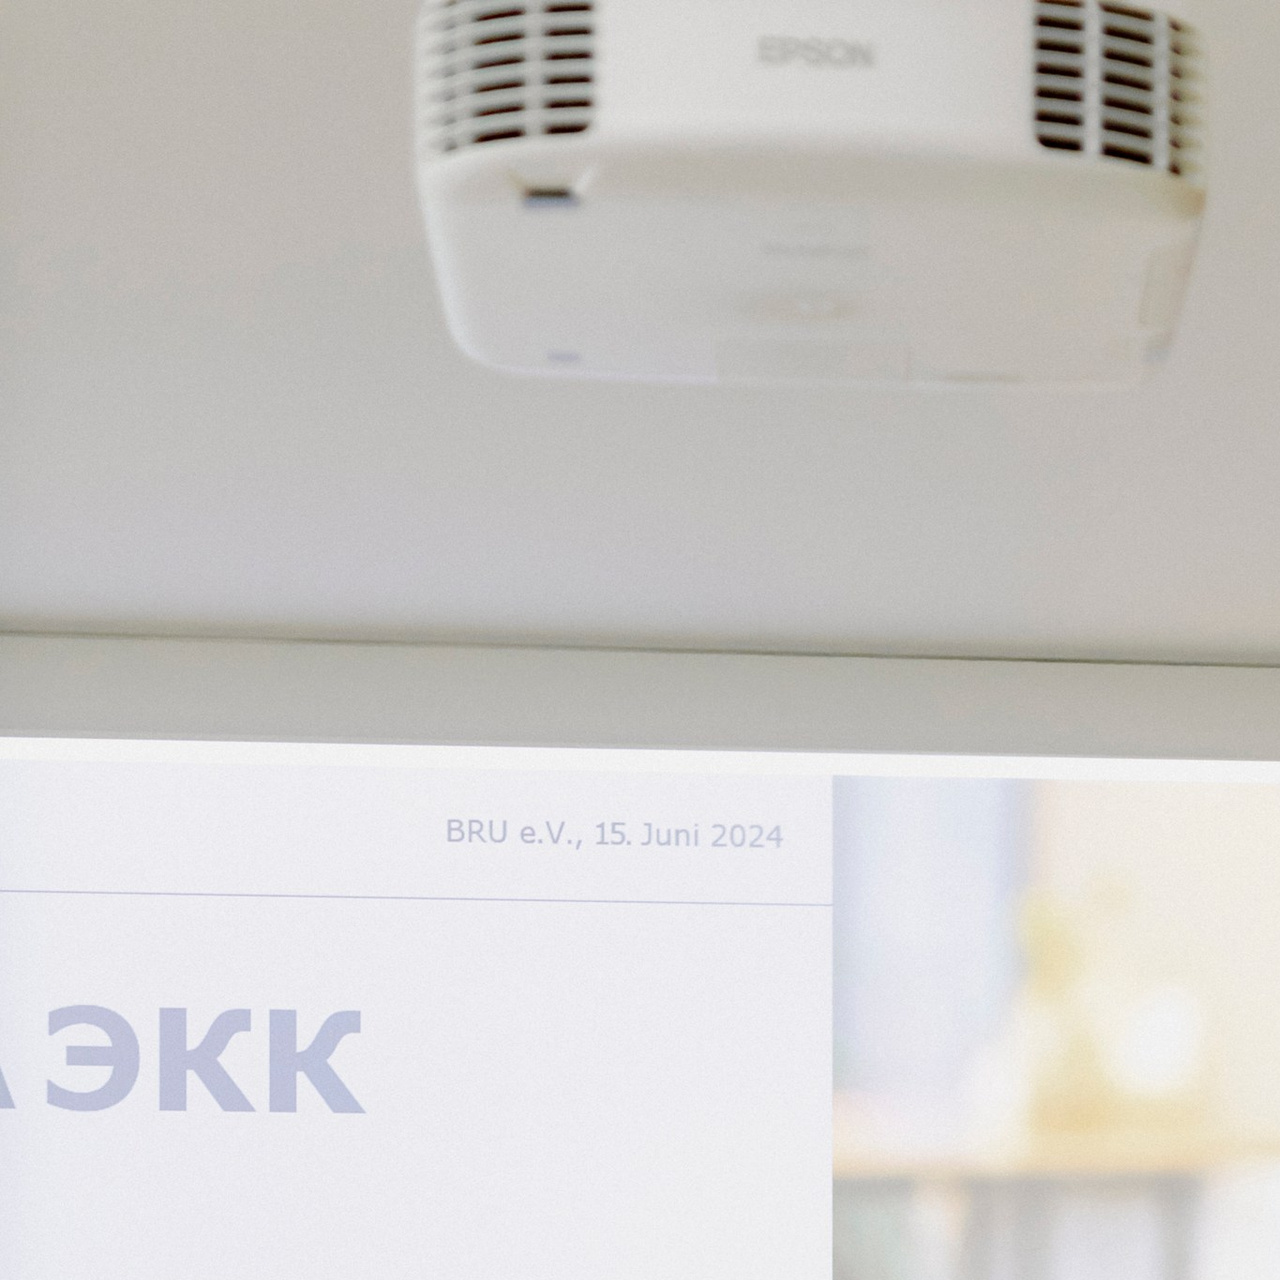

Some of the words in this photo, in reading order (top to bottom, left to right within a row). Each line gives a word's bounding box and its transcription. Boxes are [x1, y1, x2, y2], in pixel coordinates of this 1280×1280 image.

[756, 36, 875, 68] EPSON
[446, 818, 508, 844] BRU
[519, 820, 583, 850] e.V.,
[595, 821, 632, 846] 15.
[640, 822, 699, 847] Juni
[711, 823, 785, 849] 2024
[46, 1004, 366, 1114] ЭКК
